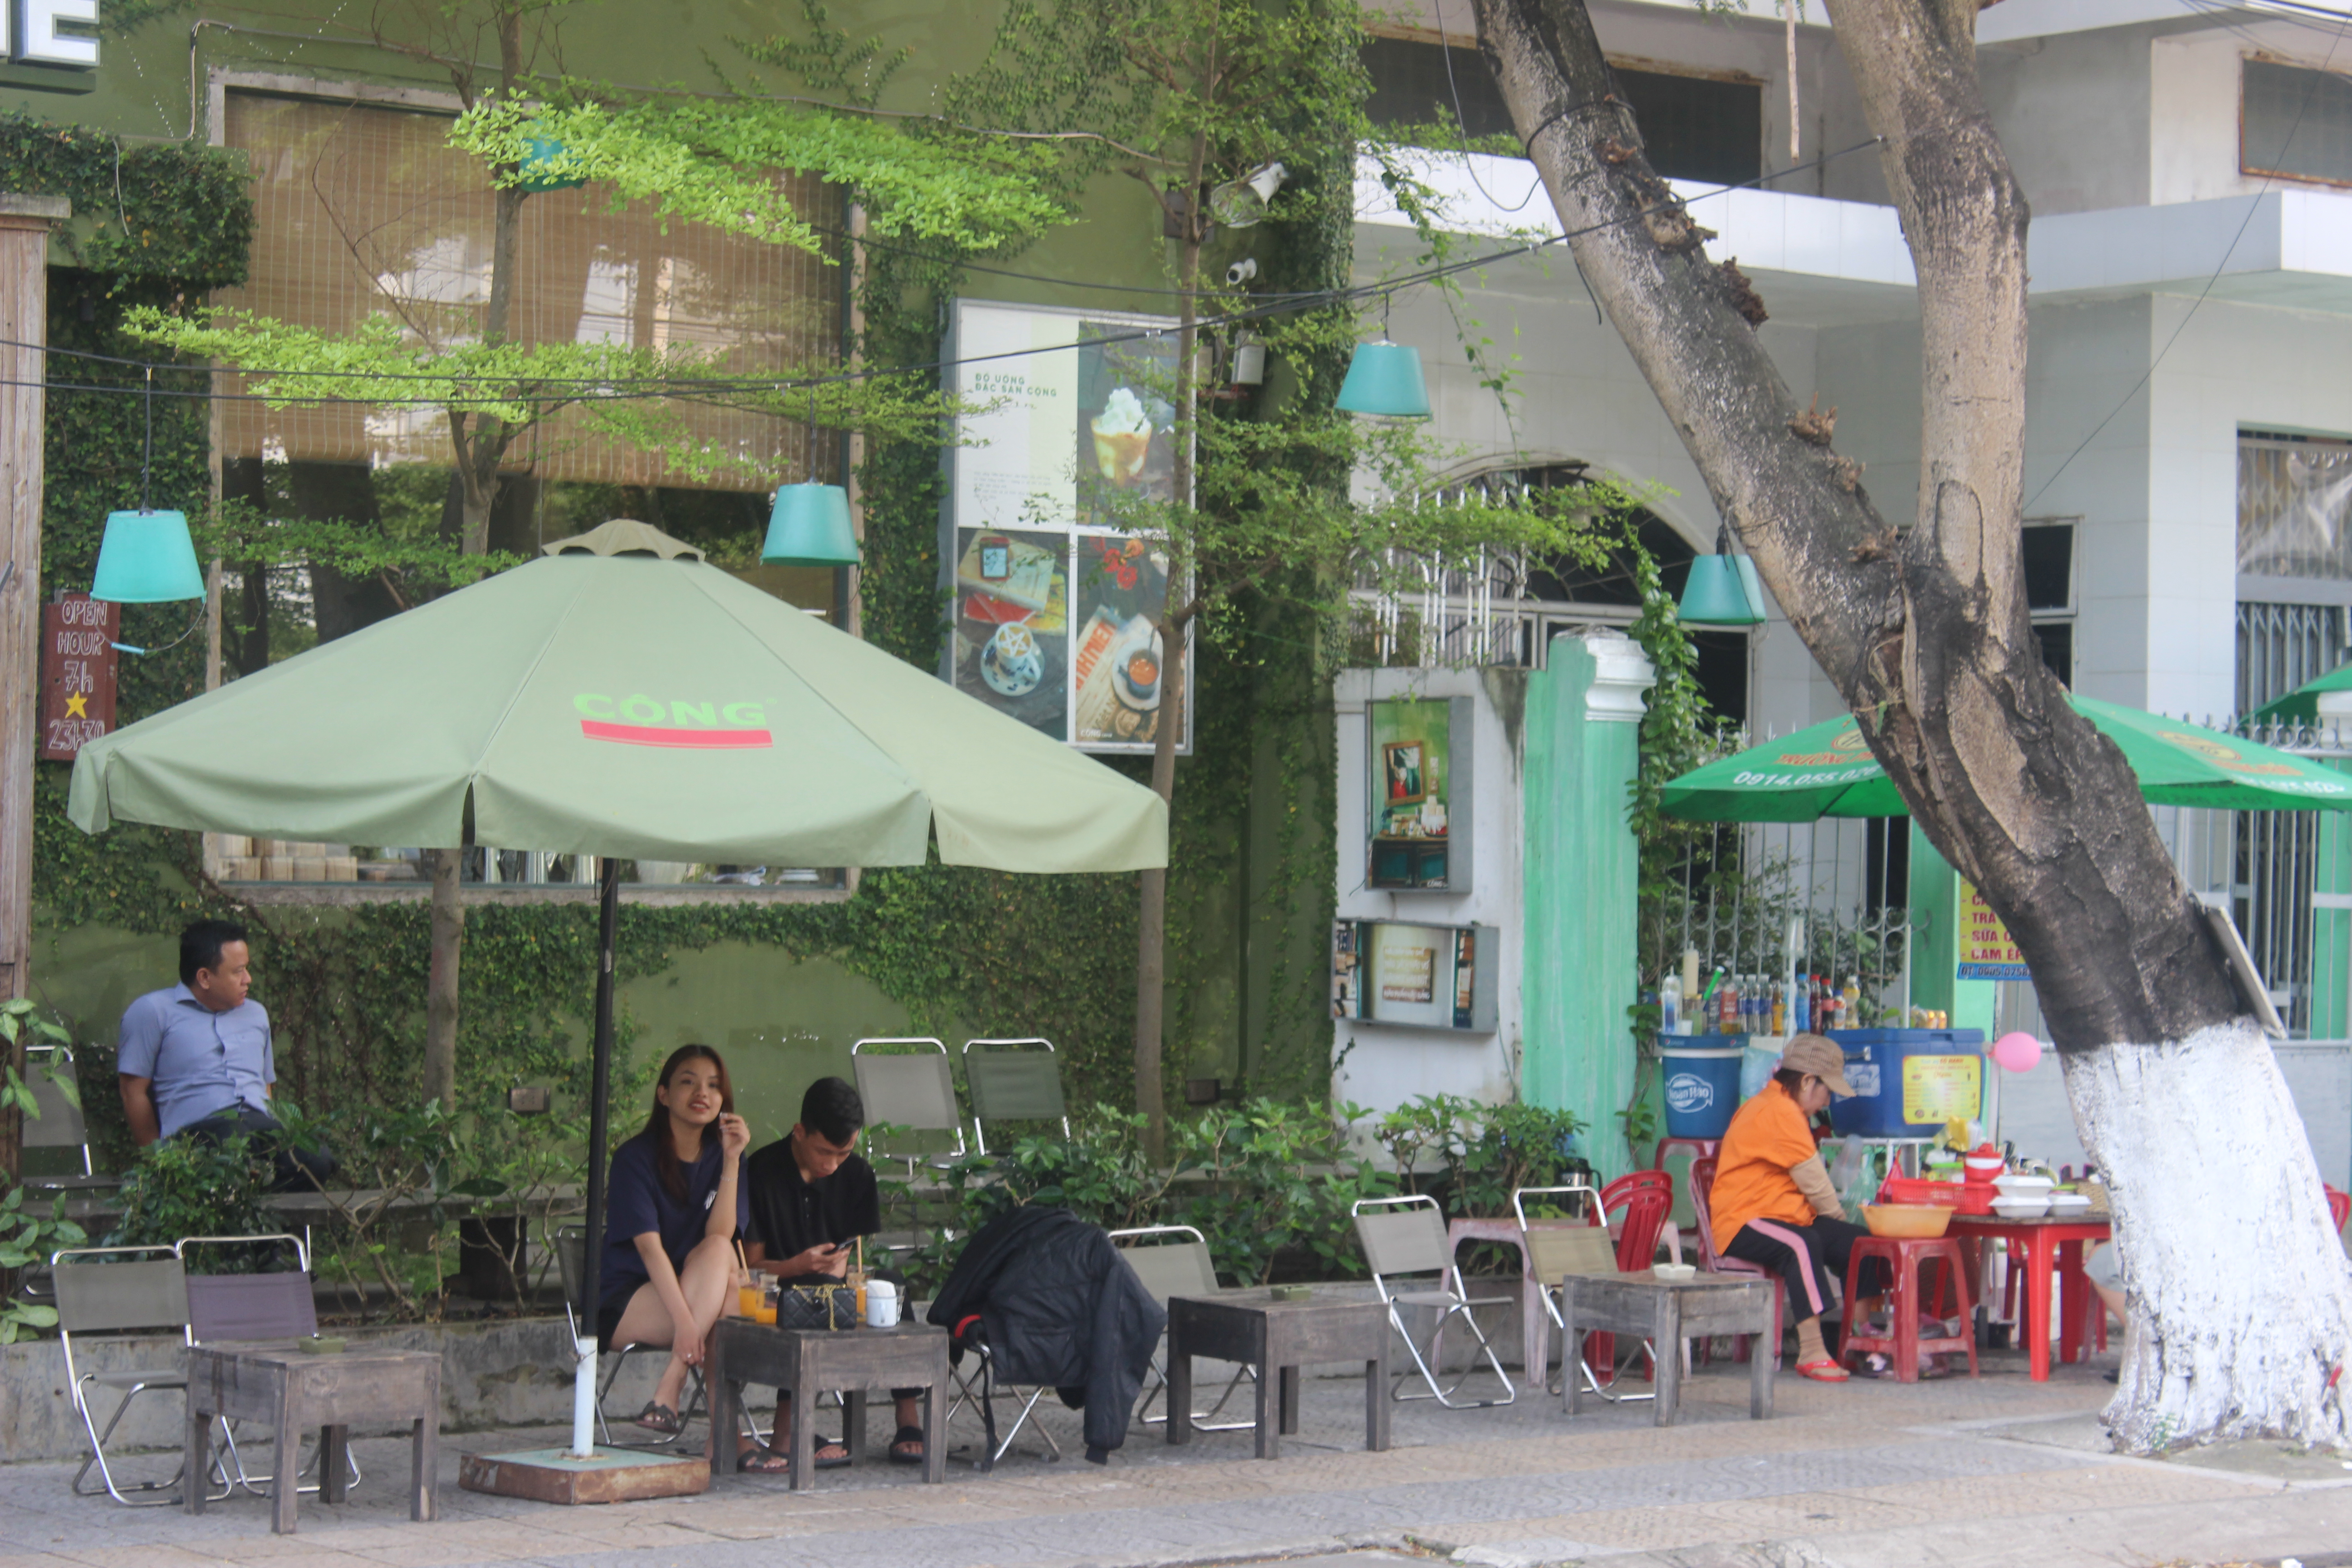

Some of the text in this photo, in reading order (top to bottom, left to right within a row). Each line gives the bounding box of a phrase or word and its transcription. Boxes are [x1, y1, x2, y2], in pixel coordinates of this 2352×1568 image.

[62, 601, 108, 626] OPEN
[58, 632, 104, 656] HOUR
[65, 661, 93, 693] 7h
[49, 719, 105, 751] 23h30
[1971, 948, 2002, 960] CAM
